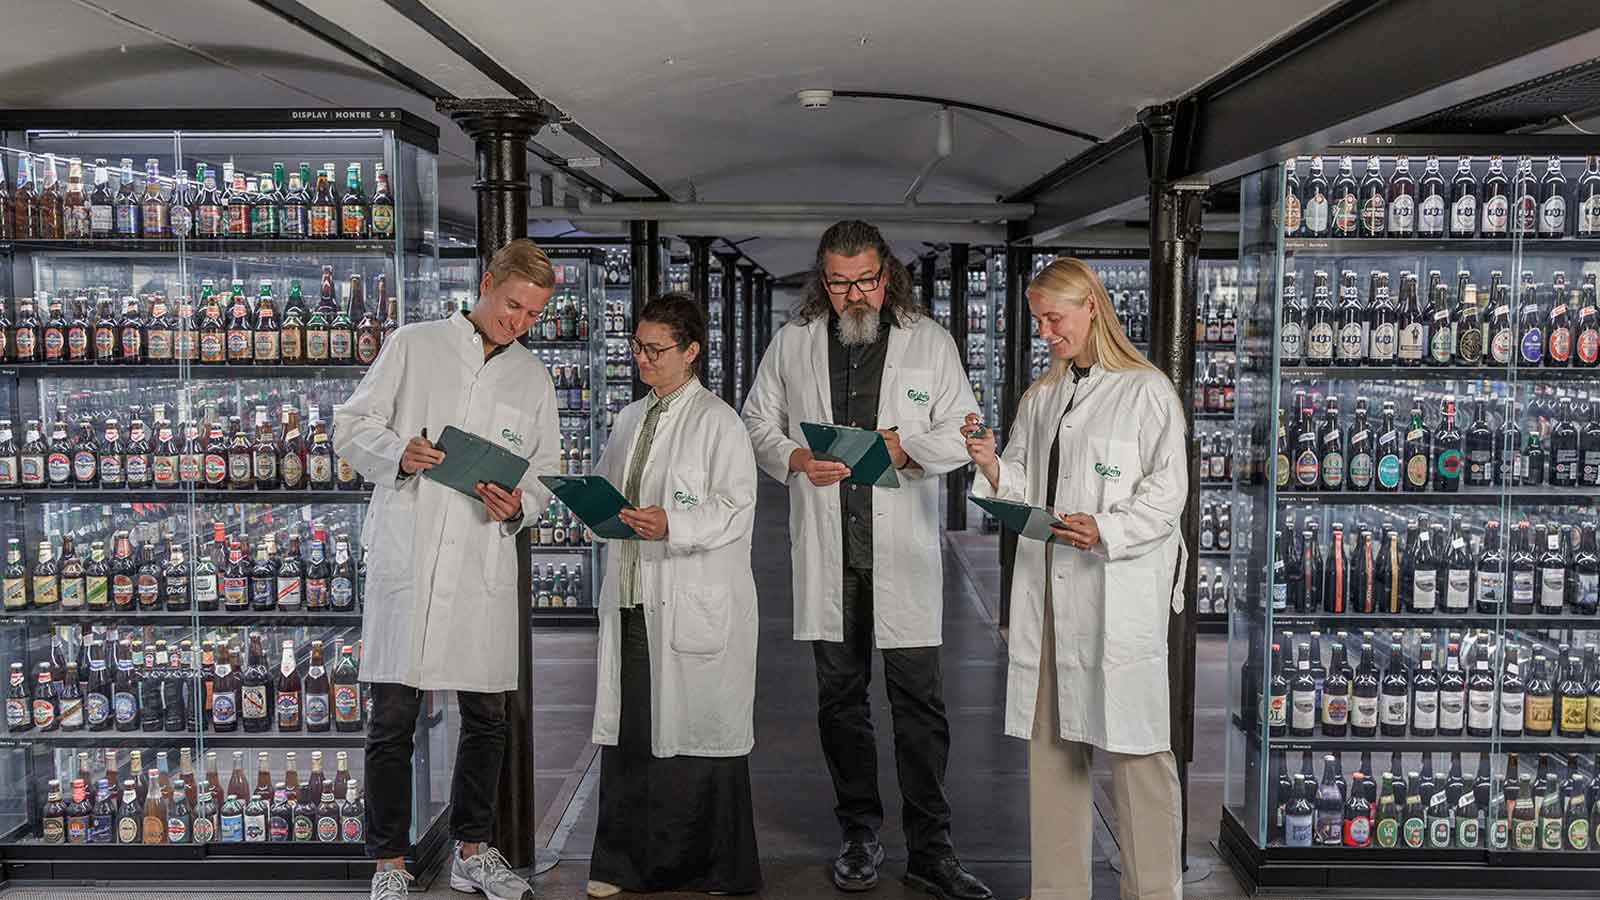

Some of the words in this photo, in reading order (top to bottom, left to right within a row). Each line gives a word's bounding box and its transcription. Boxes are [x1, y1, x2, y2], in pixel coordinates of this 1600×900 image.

[292, 111, 328, 119] DISPLAY
[335, 111, 371, 119] MONTRE
[1376, 136, 1381, 144] 1
